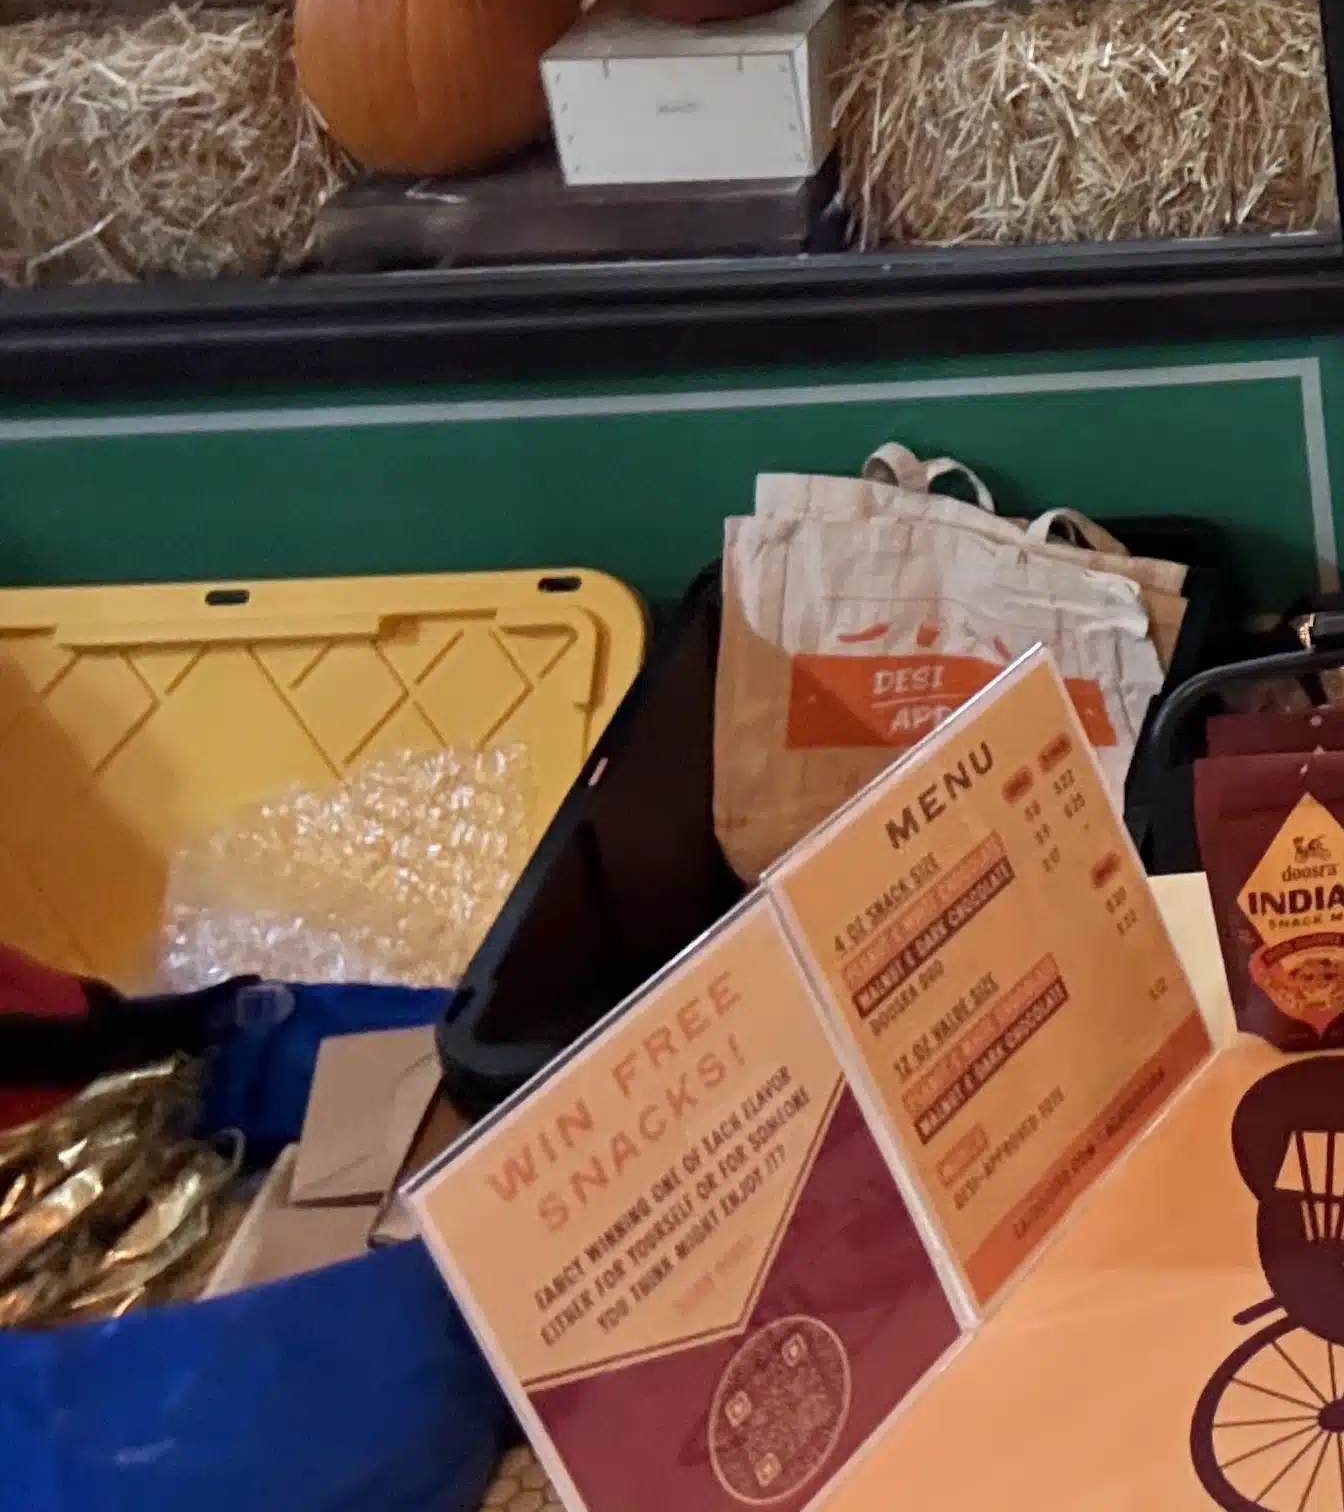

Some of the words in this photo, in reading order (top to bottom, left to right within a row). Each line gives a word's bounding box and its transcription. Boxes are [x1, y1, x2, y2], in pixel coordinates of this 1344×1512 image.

[872, 665, 944, 695] DESI
[886, 740, 993, 849] MENU
[831, 933, 848, 959] 4
[1268, 914, 1324, 930] SNACK
[1281, 861, 1338, 883] doosra
[487, 1097, 595, 1206] WIN
[612, 968, 742, 1097] FREE
[539, 1035, 744, 1233] SNACKS!
[539, 1287, 595, 1347] EITHER
[592, 1254, 629, 1298] FOR
[624, 1192, 696, 1267] YOURSELF
[693, 1169, 720, 1203] OR
[716, 1140, 749, 1181] FOR
[746, 1084, 811, 1152] SOMEONE
[582, 1194, 652, 1266] WINNING
[648, 1166, 682, 1205] ONE
[679, 1145, 703, 1176] OF
[700, 1110, 743, 1157] EACH
[740, 1064, 792, 1120] FLAVOR
[595, 1293, 632, 1336] YOU
[628, 1251, 676, 1304] THINK
[671, 1207, 720, 1261] MIGHT
[718, 1167, 766, 1217] ENJOY
[761, 1141, 789, 1175] IT?
